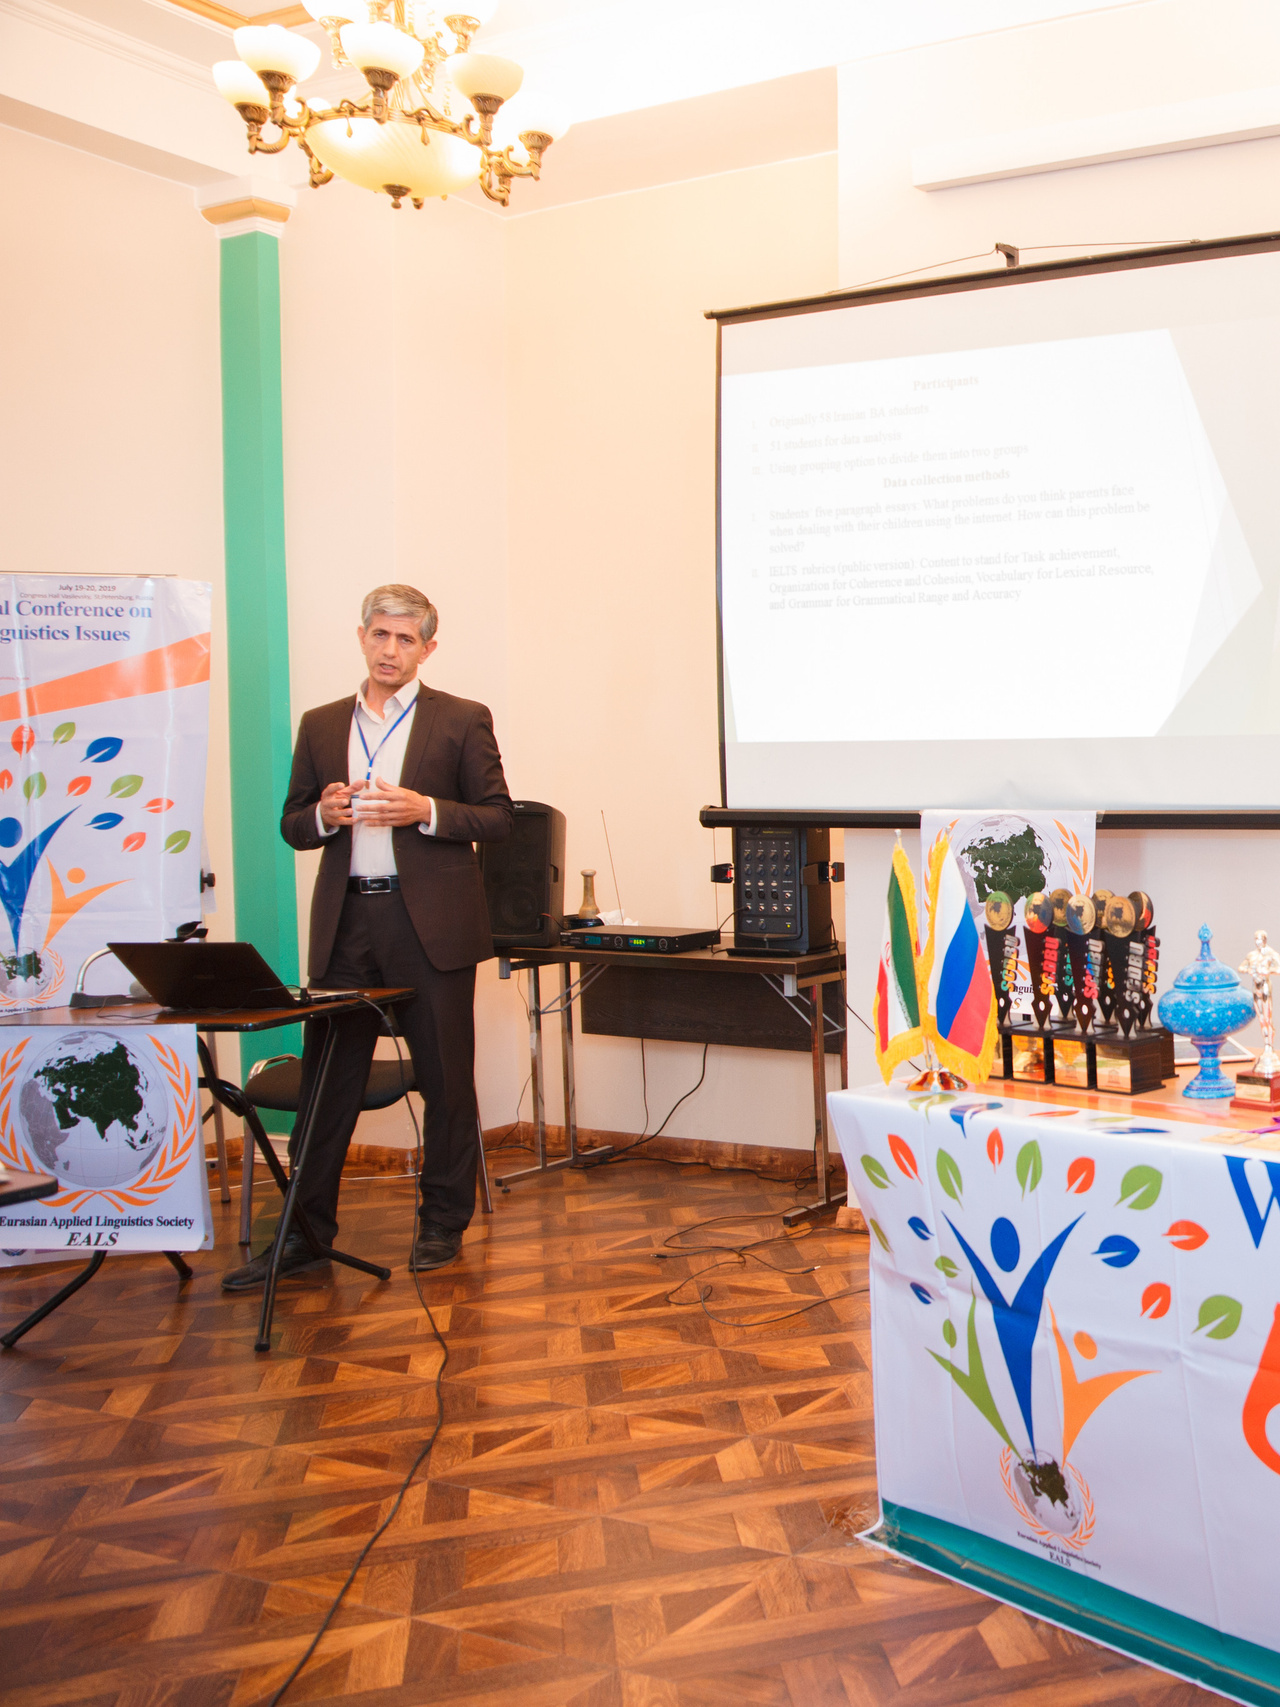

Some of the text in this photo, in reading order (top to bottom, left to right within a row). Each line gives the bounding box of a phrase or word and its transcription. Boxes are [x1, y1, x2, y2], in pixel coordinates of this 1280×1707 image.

[58, 584, 73, 592] July
[16, 600, 124, 617] Conference
[129, 605, 152, 618] on
[75, 625, 131, 641] Issues
[0, 1216, 195, 1229] Eurasian Applied Linguistics Society
[65, 1231, 120, 1247] EALS
